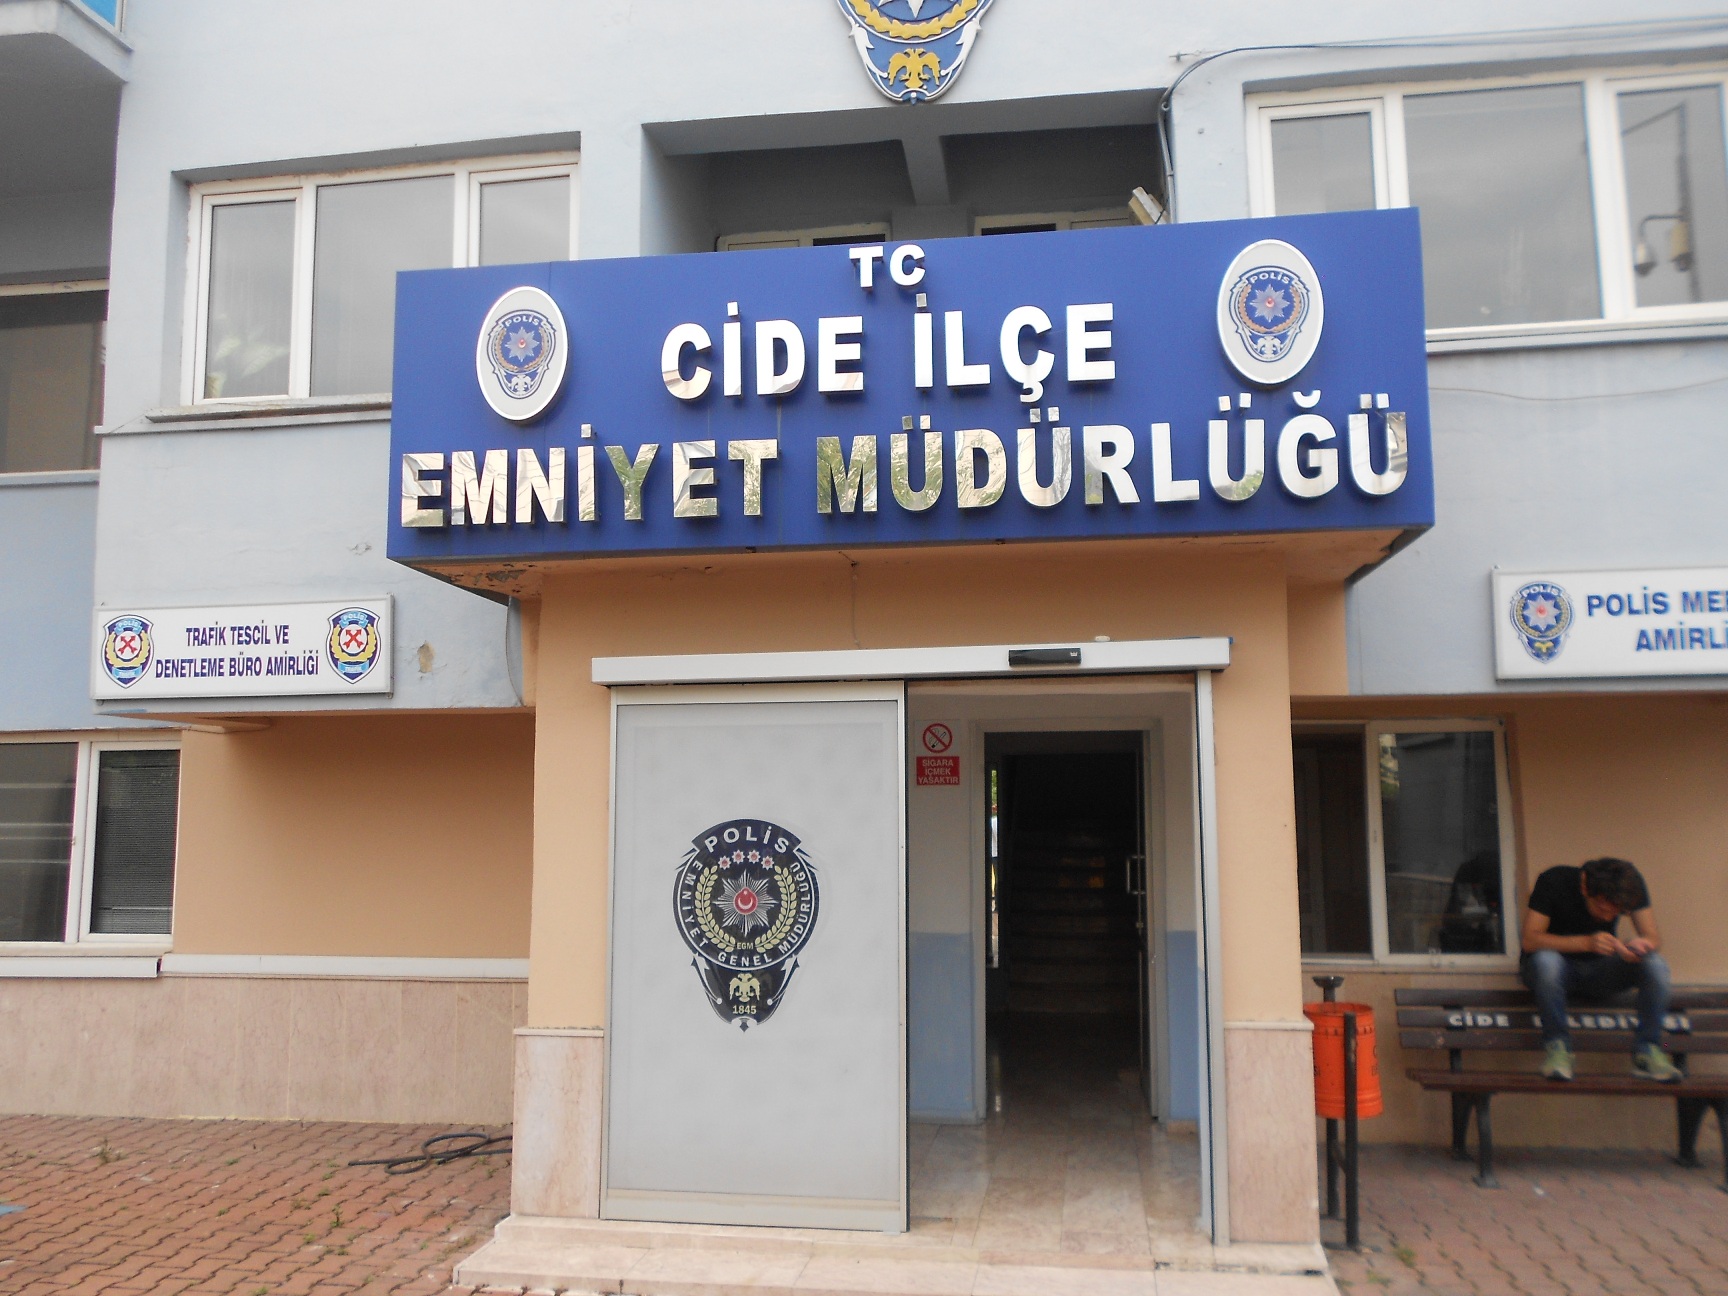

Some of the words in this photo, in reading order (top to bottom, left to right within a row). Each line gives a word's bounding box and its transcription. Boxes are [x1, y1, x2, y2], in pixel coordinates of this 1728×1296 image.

[849, 244, 926, 288] TC
[1250, 271, 1290, 284] POLİS
[505, 314, 540, 327] POLİS
[661, 301, 864, 400] CİDE
[914, 293, 1116, 402] İLÇE
[401, 423, 779, 528] EMNİYET
[817, 389, 1409, 515] MÜDÜRLÜĞÜ
[1522, 584, 1560, 598] POLİS
[1587, 586, 1670, 617] POLİS
[1681, 590, 1728, 614] ME
[186, 621, 228, 647] TRAFİK
[230, 620, 272, 646] TESCİL
[273, 624, 290, 645] VE
[155, 657, 225, 679] DENETLEME
[228, 651, 263, 677] BÜRO
[265, 649, 320, 676] AMİRLİĞİ
[922, 757, 953, 767] SİGARA
[918, 776, 959, 784] YASAKTIR
[704, 826, 790, 853] POLİS
[682, 860, 709, 948] EMNİYET
[717, 951, 773, 967] GENEL
[778, 862, 811, 954] MÜDÜRLÜĞÜ
[736, 941, 754, 950] EGM
[732, 1005, 757, 1015] 1845
[1449, 1011, 1509, 1027] CİDE
